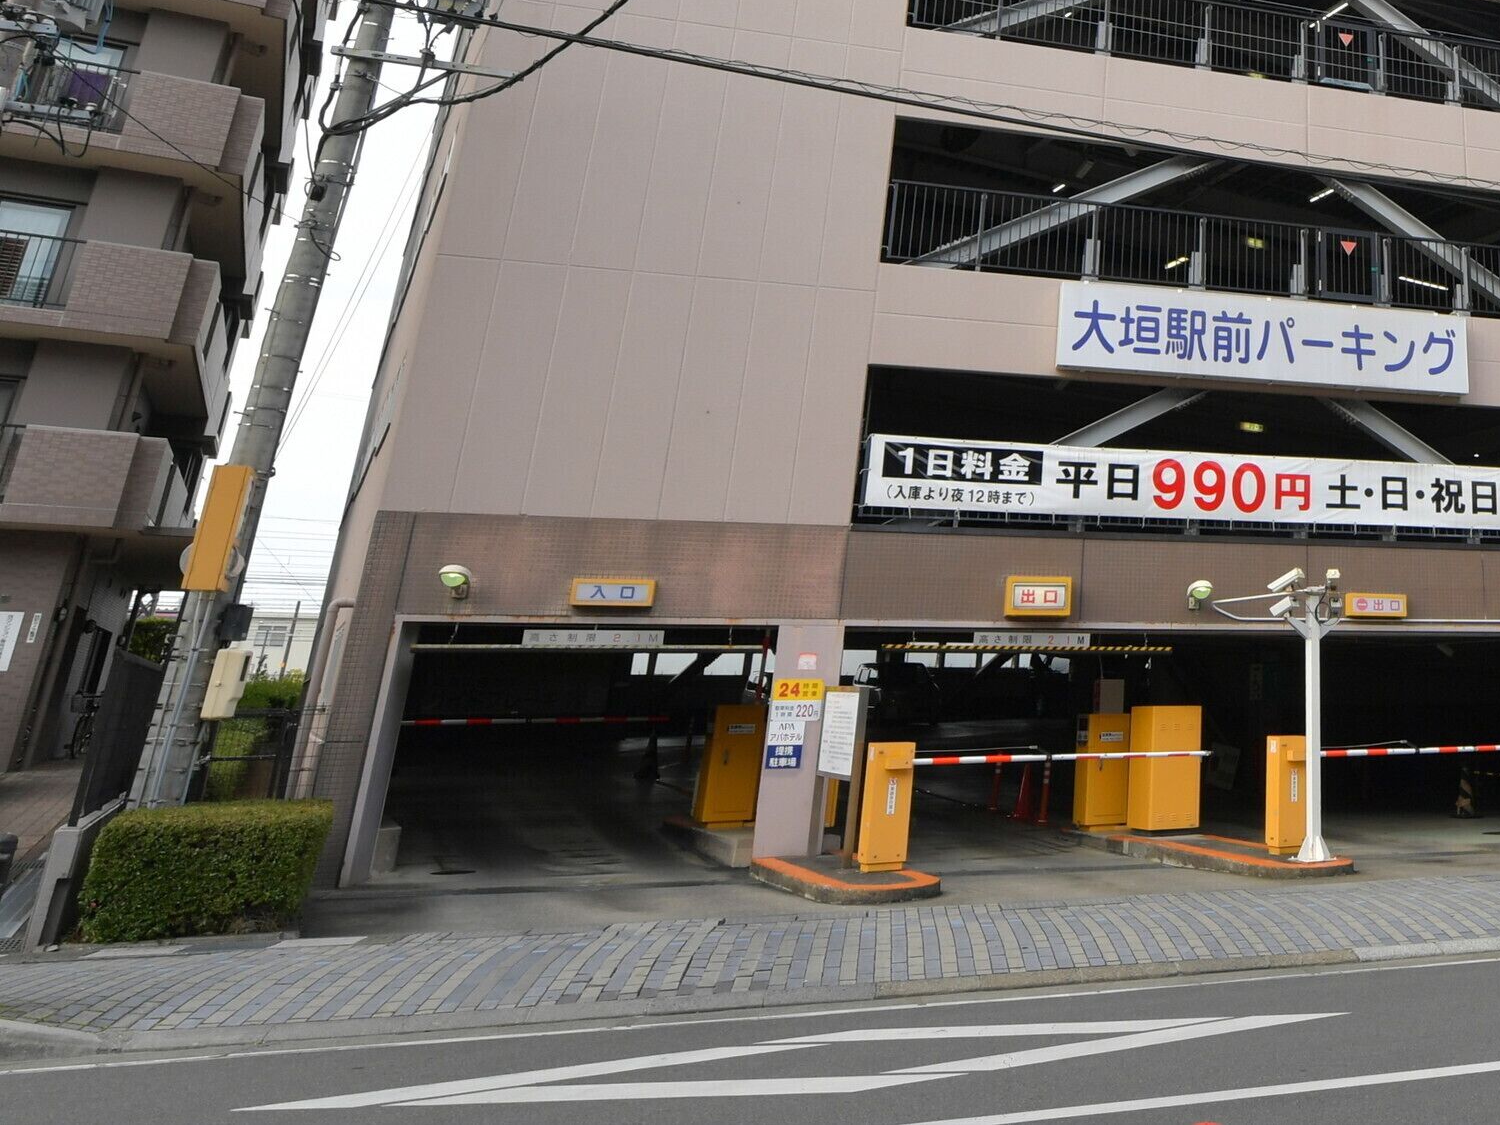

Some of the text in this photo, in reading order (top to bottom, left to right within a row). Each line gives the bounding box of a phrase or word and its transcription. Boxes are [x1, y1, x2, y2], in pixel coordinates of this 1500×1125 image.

[1071, 299, 1457, 376] 大垣駅前パーキング
[897, 447, 1031, 482] 1日料金
[1056, 461, 1140, 501] 平日
[1152, 458, 1311, 513] 990円
[1326, 474, 1497, 515] 土・日・祝日
[591, 586, 635, 599] 入口
[1021, 589, 1058, 604] 出口
[1374, 599, 1400, 611] 出口
[779, 683, 800, 698] 24
[769, 733, 802, 742] アパホテル
